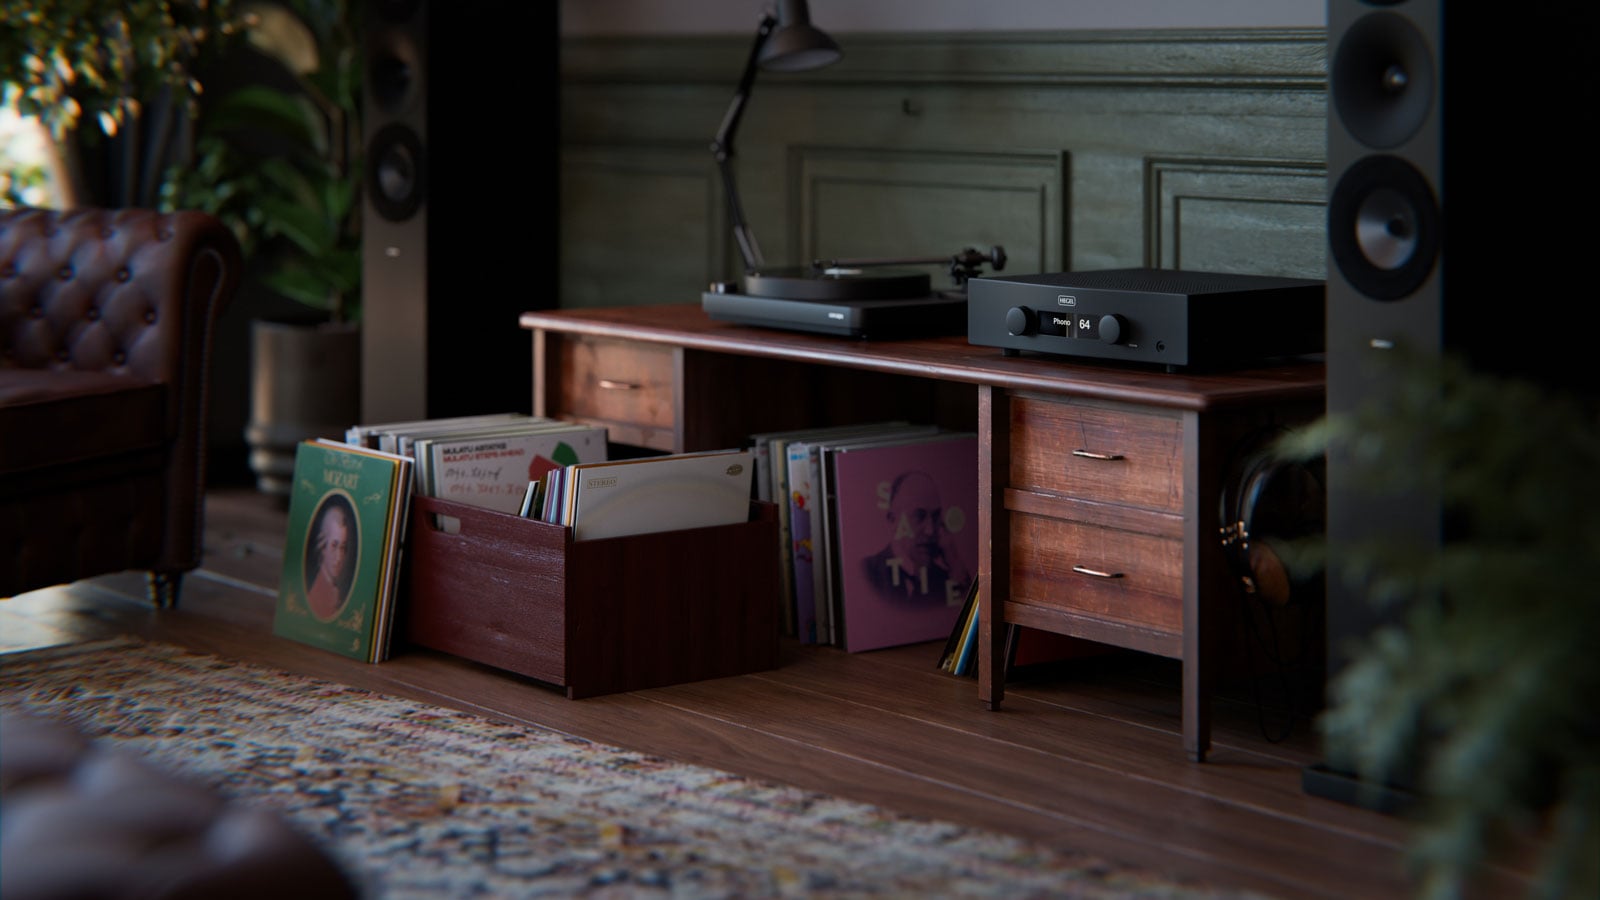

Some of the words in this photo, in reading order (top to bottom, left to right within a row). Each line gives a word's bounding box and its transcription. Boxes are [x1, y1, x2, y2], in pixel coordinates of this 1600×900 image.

[1059, 297, 1074, 305] HEGEL
[1053, 317, 1071, 326] Phono
[1079, 319, 1091, 330] 64
[443, 445, 473, 455] MULATU
[443, 453, 474, 463] MULATU
[323, 468, 360, 491] MOZART
[588, 479, 616, 487] STEREO
